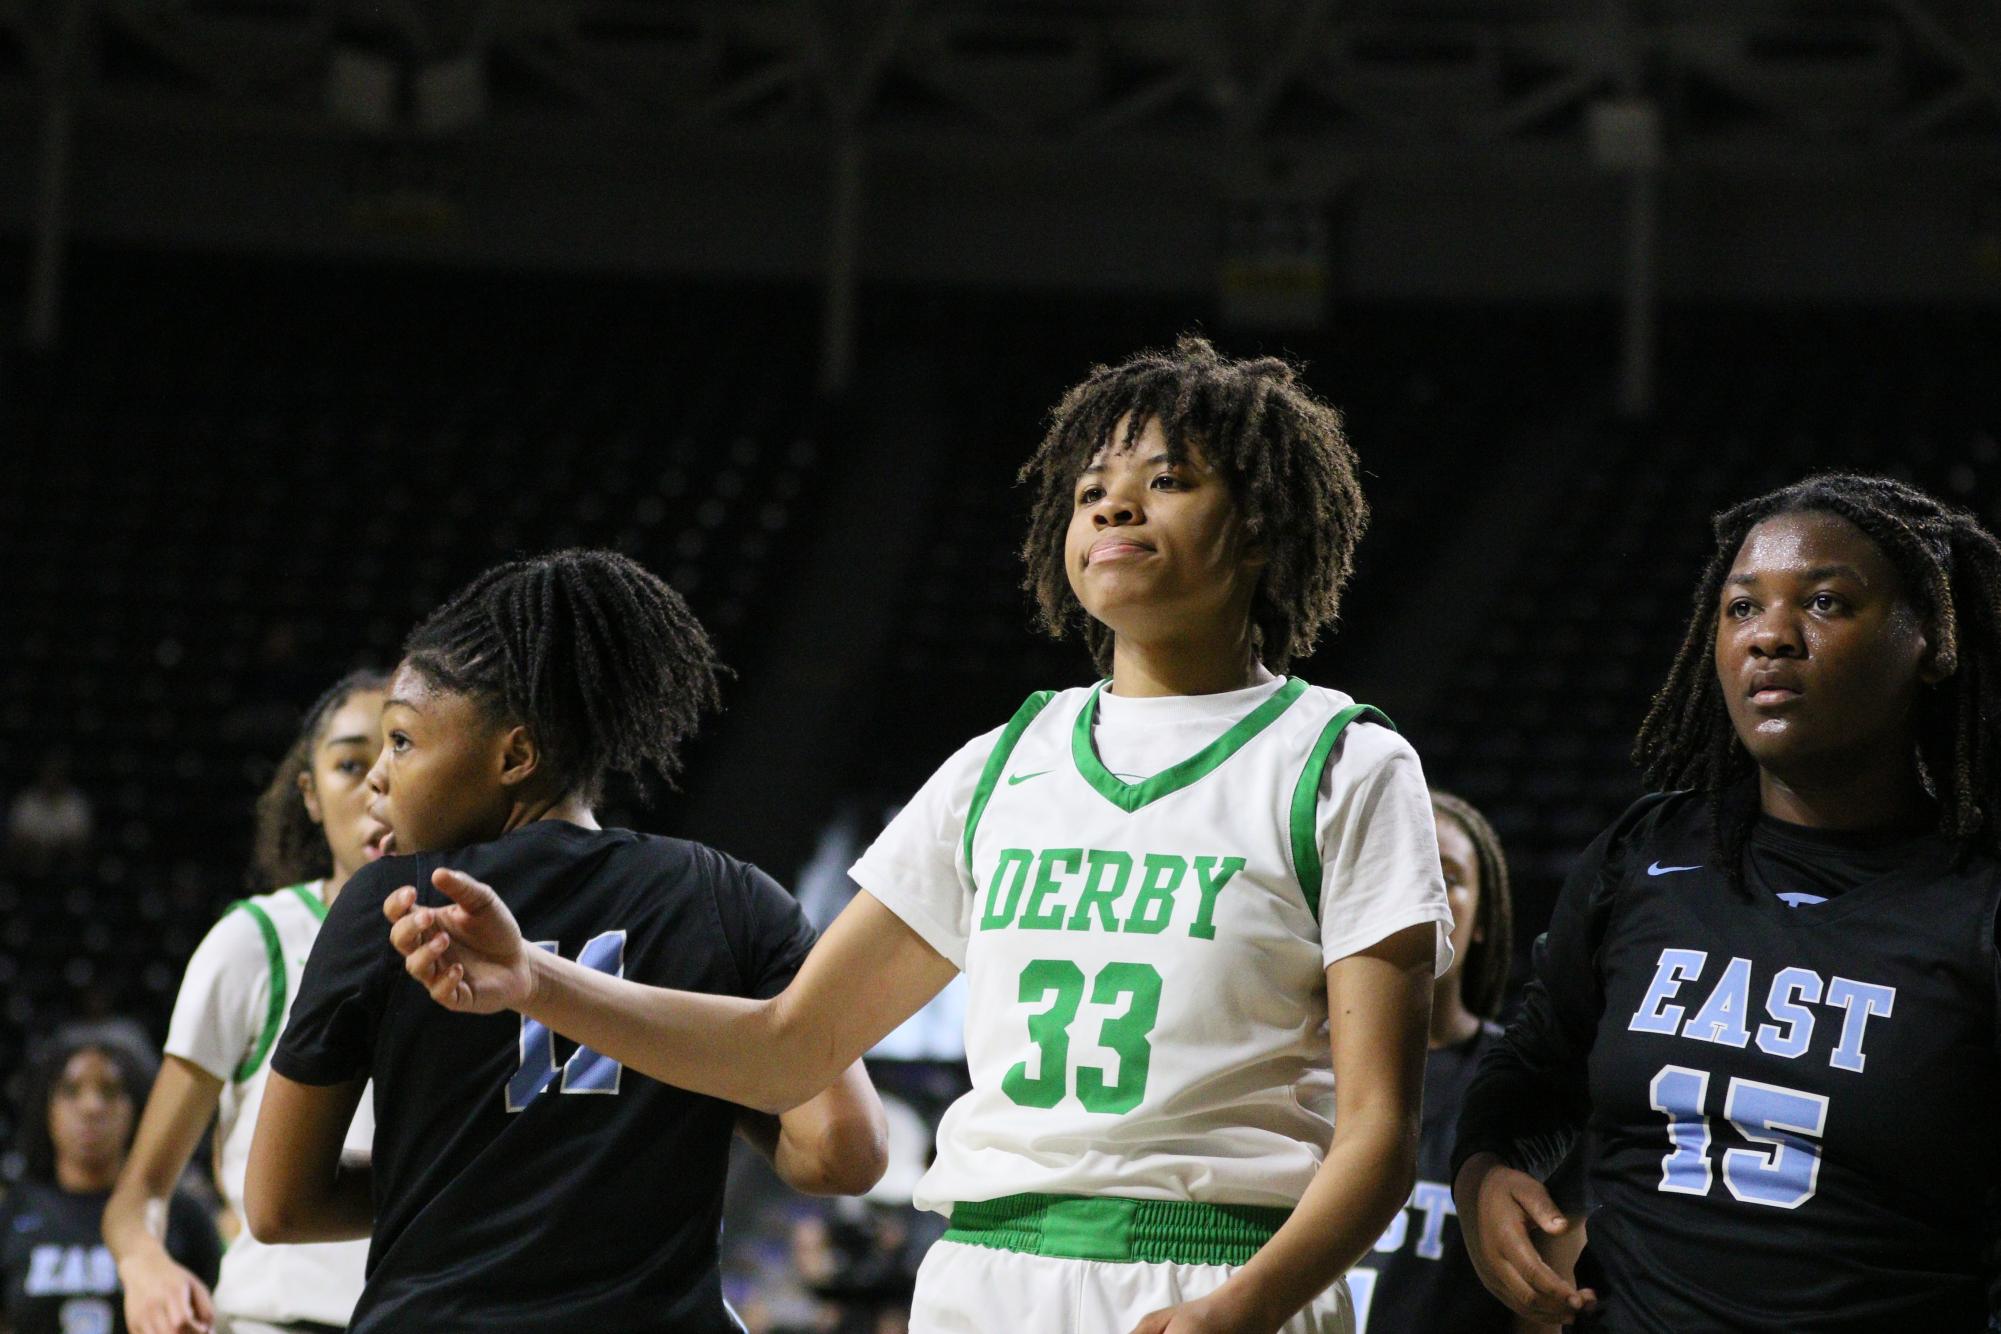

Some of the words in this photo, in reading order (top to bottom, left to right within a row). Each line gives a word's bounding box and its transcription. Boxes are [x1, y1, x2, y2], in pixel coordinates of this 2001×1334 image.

[980, 847, 1247, 940] DERBY
[1001, 959, 1163, 1115] 33
[1628, 948, 1896, 1073] EAST
[1649, 1064, 1830, 1209] 15
